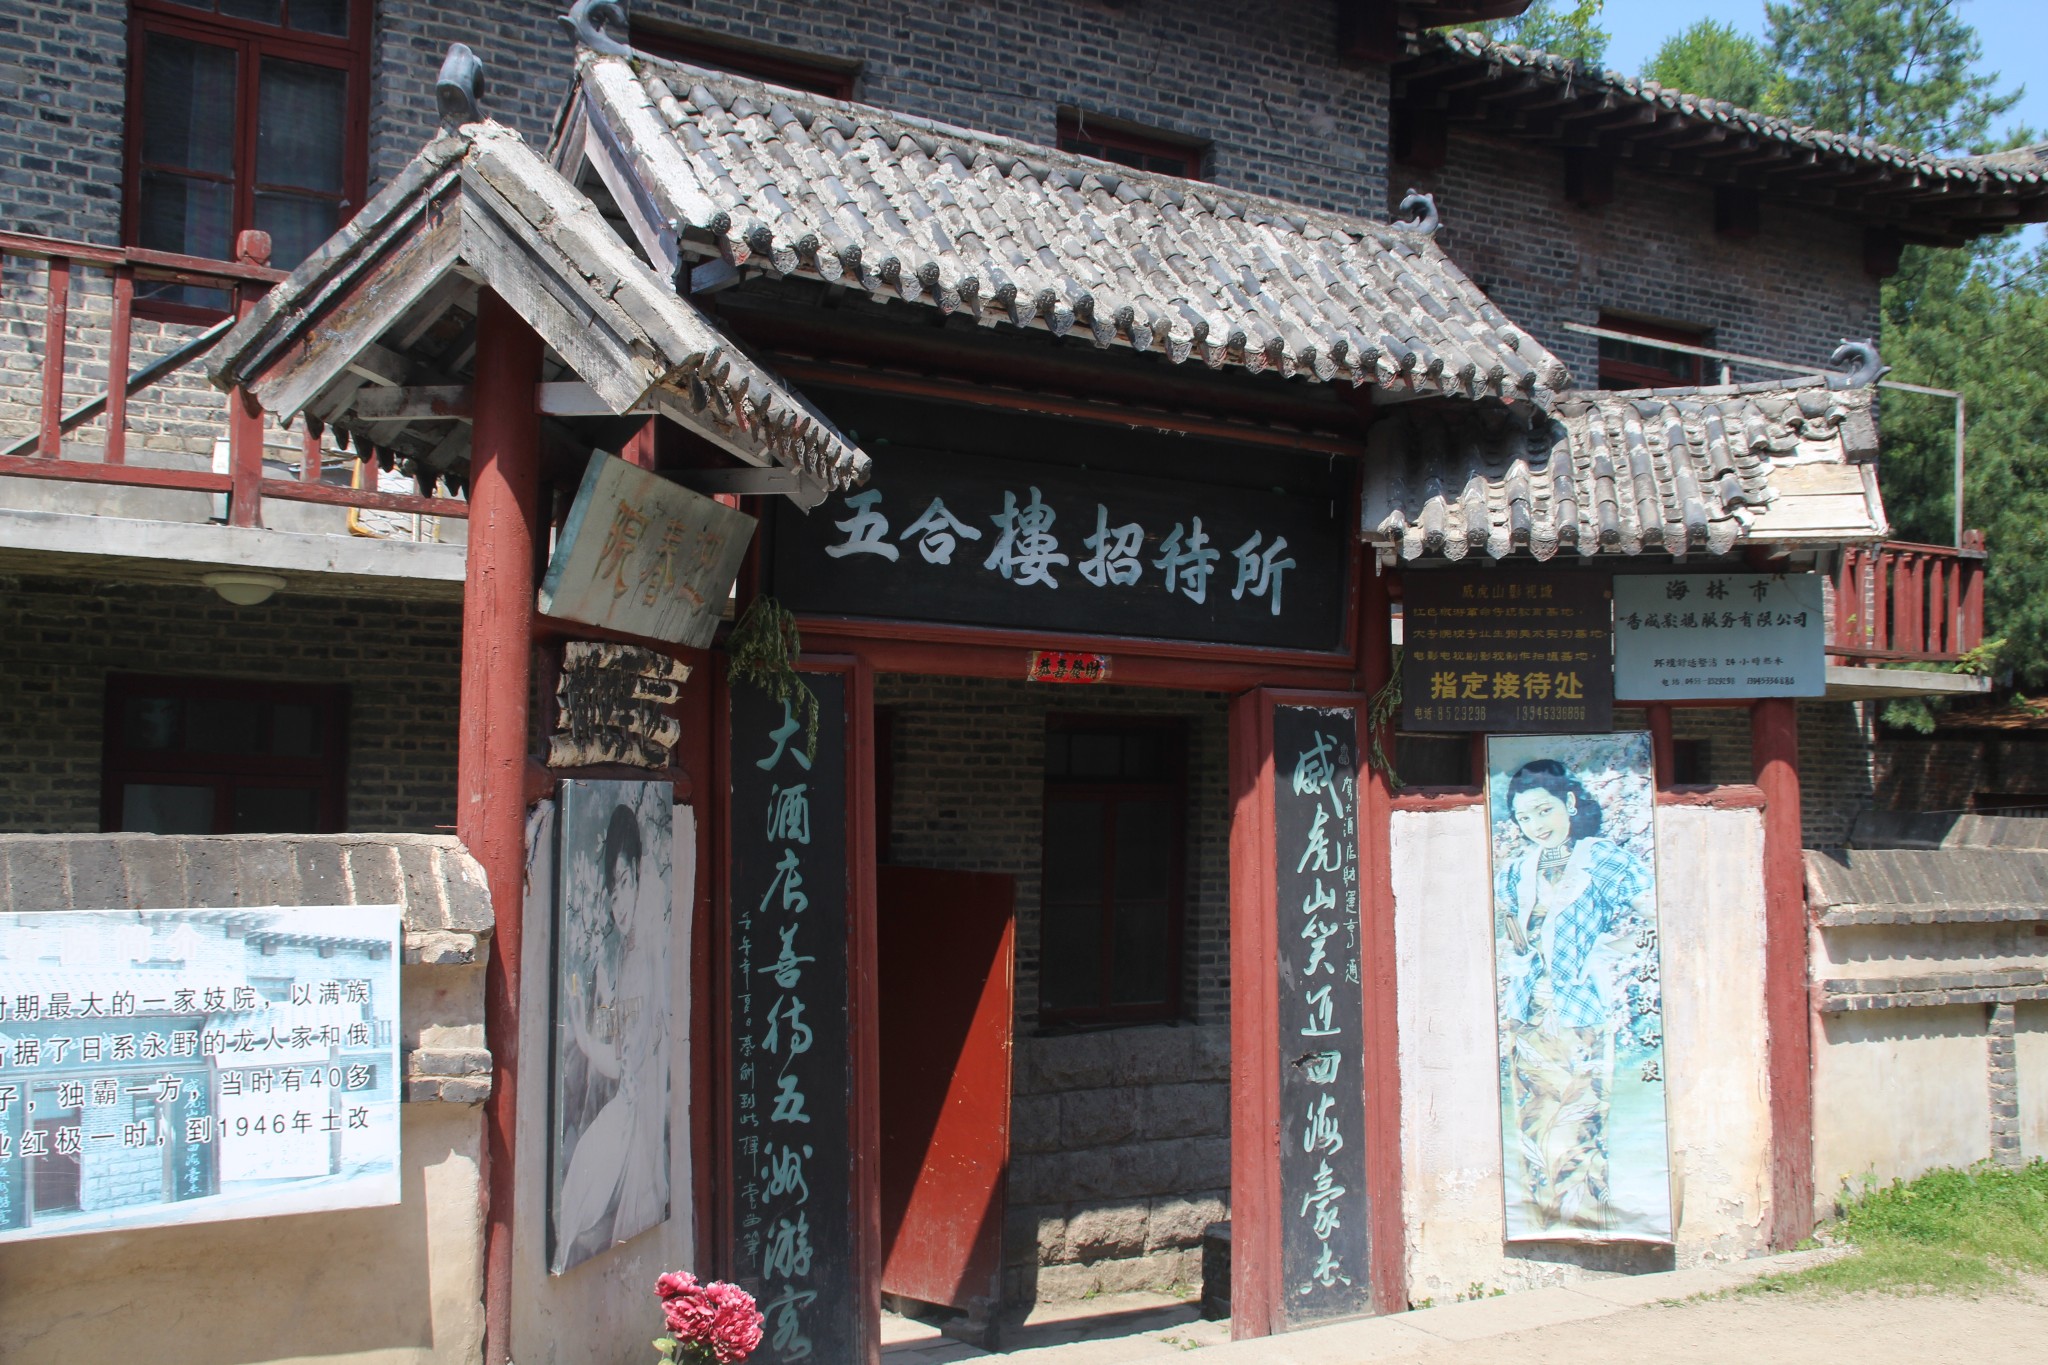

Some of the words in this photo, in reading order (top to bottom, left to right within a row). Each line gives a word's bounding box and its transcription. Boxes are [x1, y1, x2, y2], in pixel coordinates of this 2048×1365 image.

[825, 486, 1297, 616] 五合樓招待所
[1665, 579, 1770, 602] 海林市
[1430, 671, 1584, 700] 指定接待处
